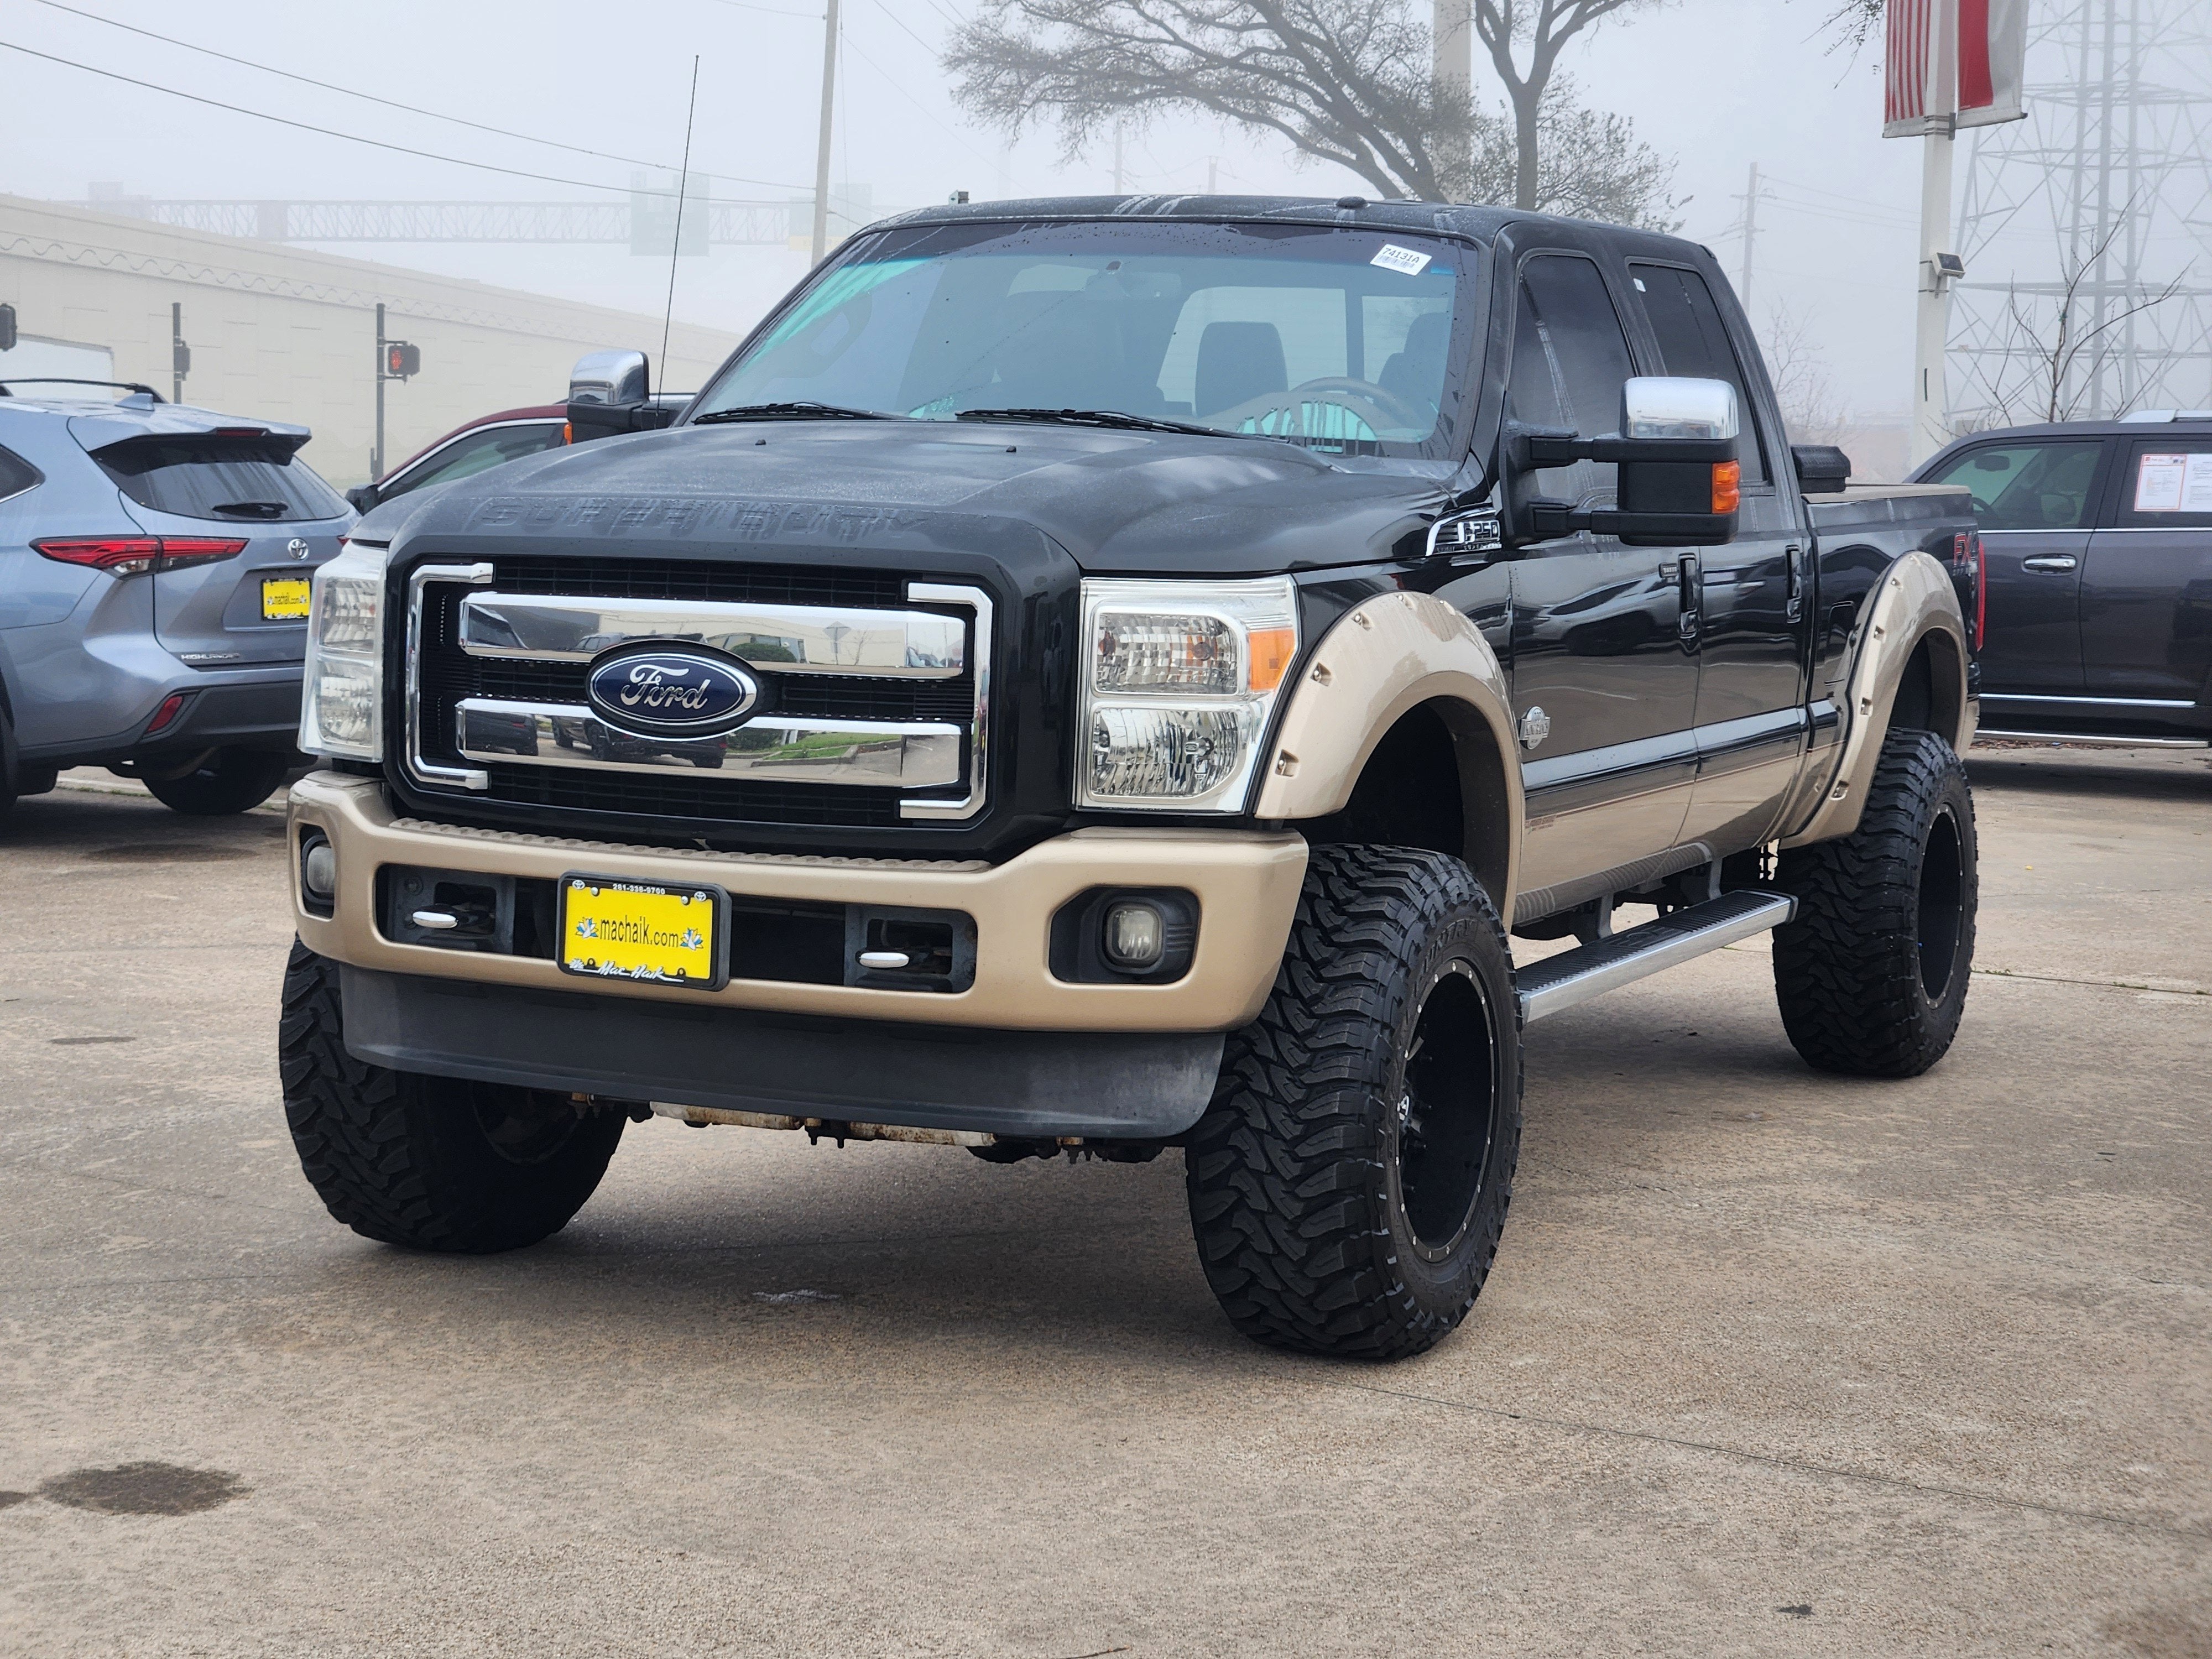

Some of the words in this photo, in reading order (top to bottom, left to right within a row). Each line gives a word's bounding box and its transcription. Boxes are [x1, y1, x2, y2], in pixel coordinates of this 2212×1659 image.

[1382, 247, 1420, 264] 74131A
[620, 664, 712, 710] Ford
[600, 914, 679, 948] machaik.com
[599, 961, 630, 976] Mac
[630, 964, 685, 983] Haik
